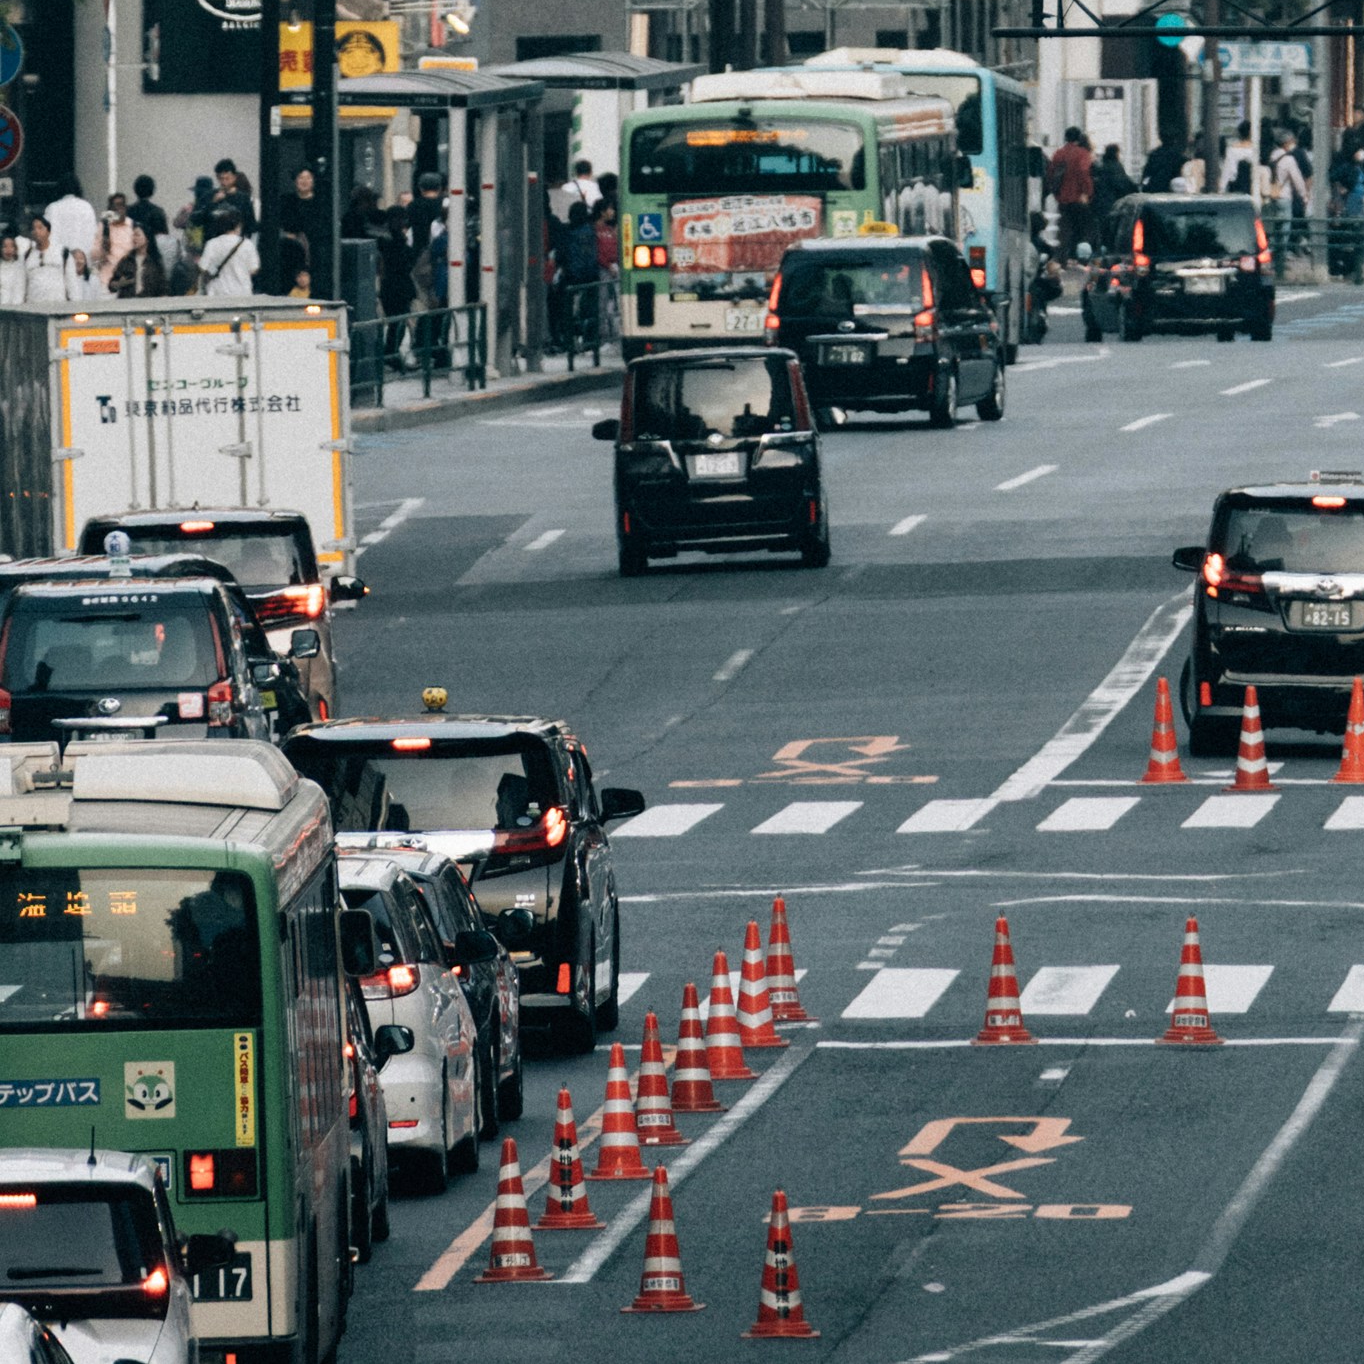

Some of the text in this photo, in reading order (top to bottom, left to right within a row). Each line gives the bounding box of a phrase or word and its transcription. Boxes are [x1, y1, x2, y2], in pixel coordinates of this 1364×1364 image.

[125, 395, 301, 418] 東京納品代行株式会社
[1312, 611, 1350, 626] 82-15
